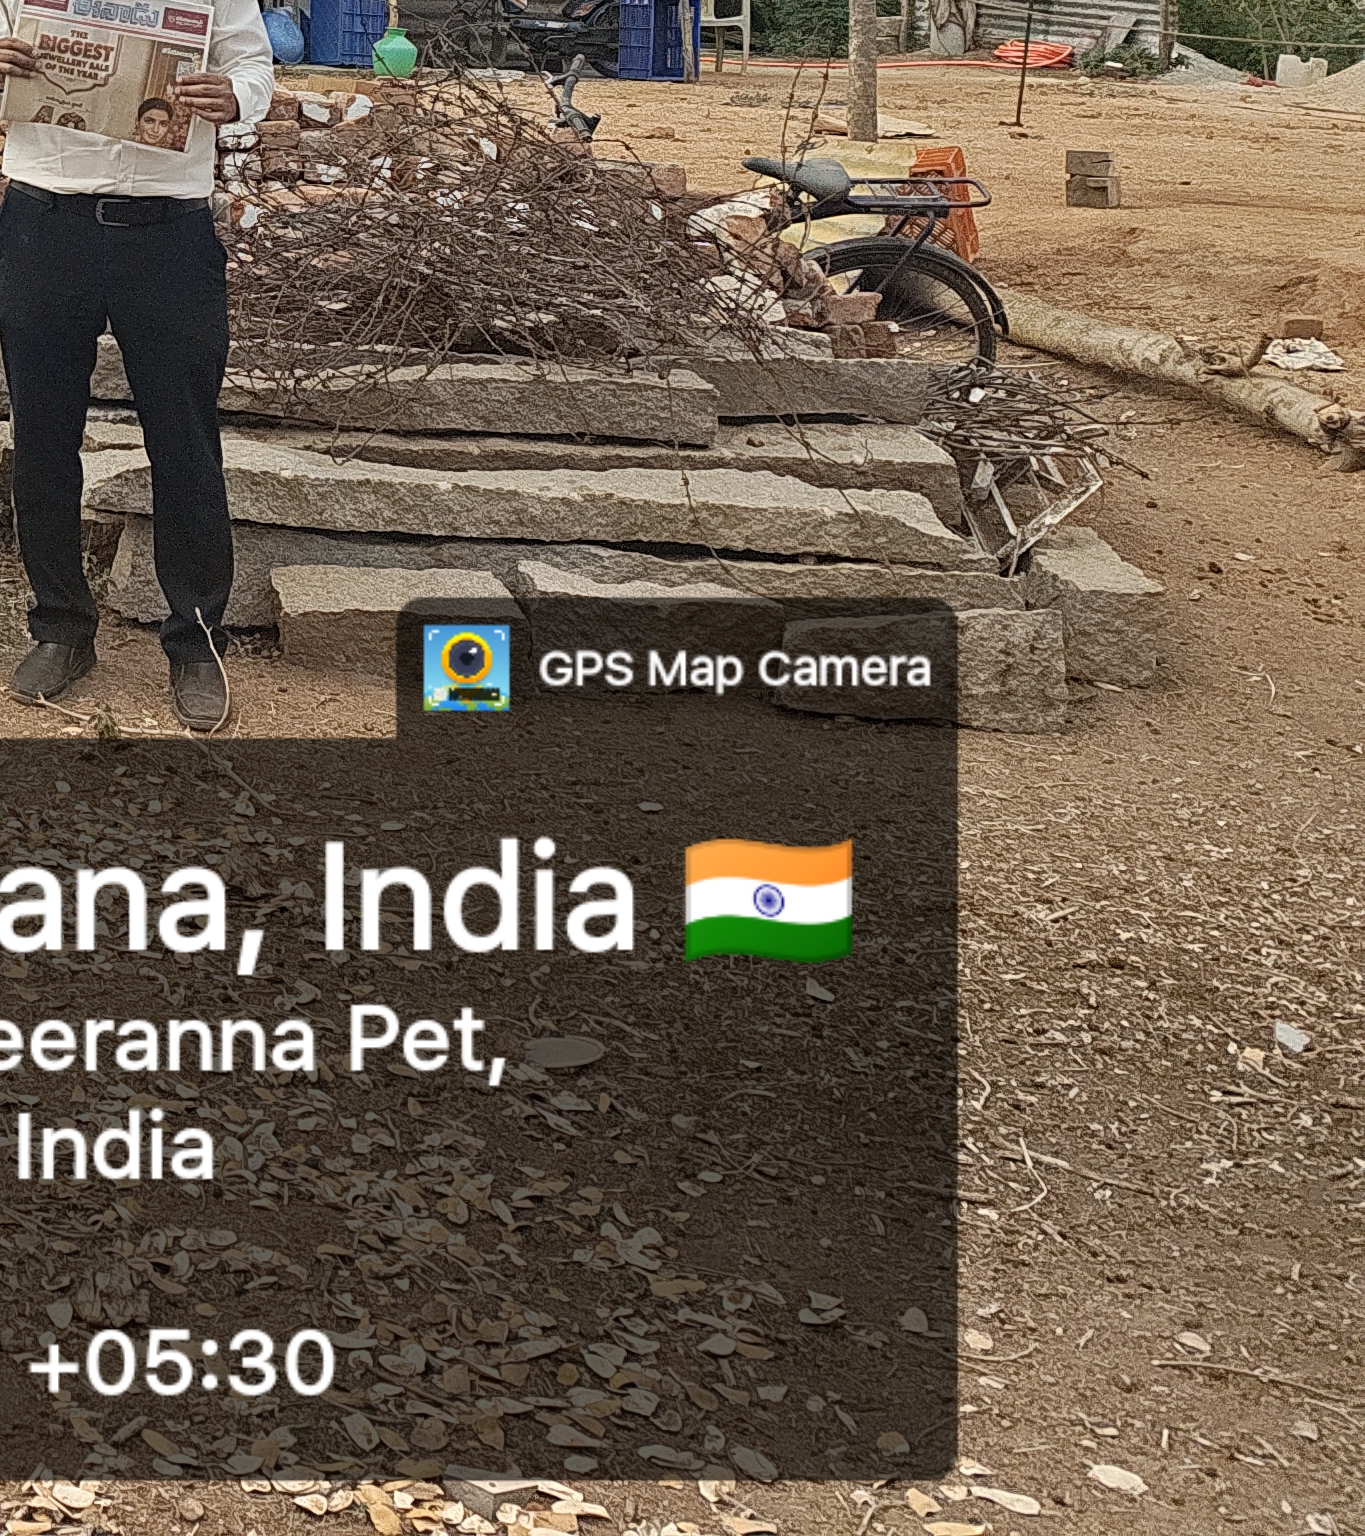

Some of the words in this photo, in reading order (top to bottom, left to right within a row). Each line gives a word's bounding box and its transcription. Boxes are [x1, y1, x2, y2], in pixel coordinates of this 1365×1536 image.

[70, 29, 89, 40] THE
[38, 33, 115, 63] BIGGEST
[44, 62, 57, 71] OF
[58, 65, 76, 76] THE
[76, 68, 100, 81] YEAR
[88, 61, 111, 73] SALE
